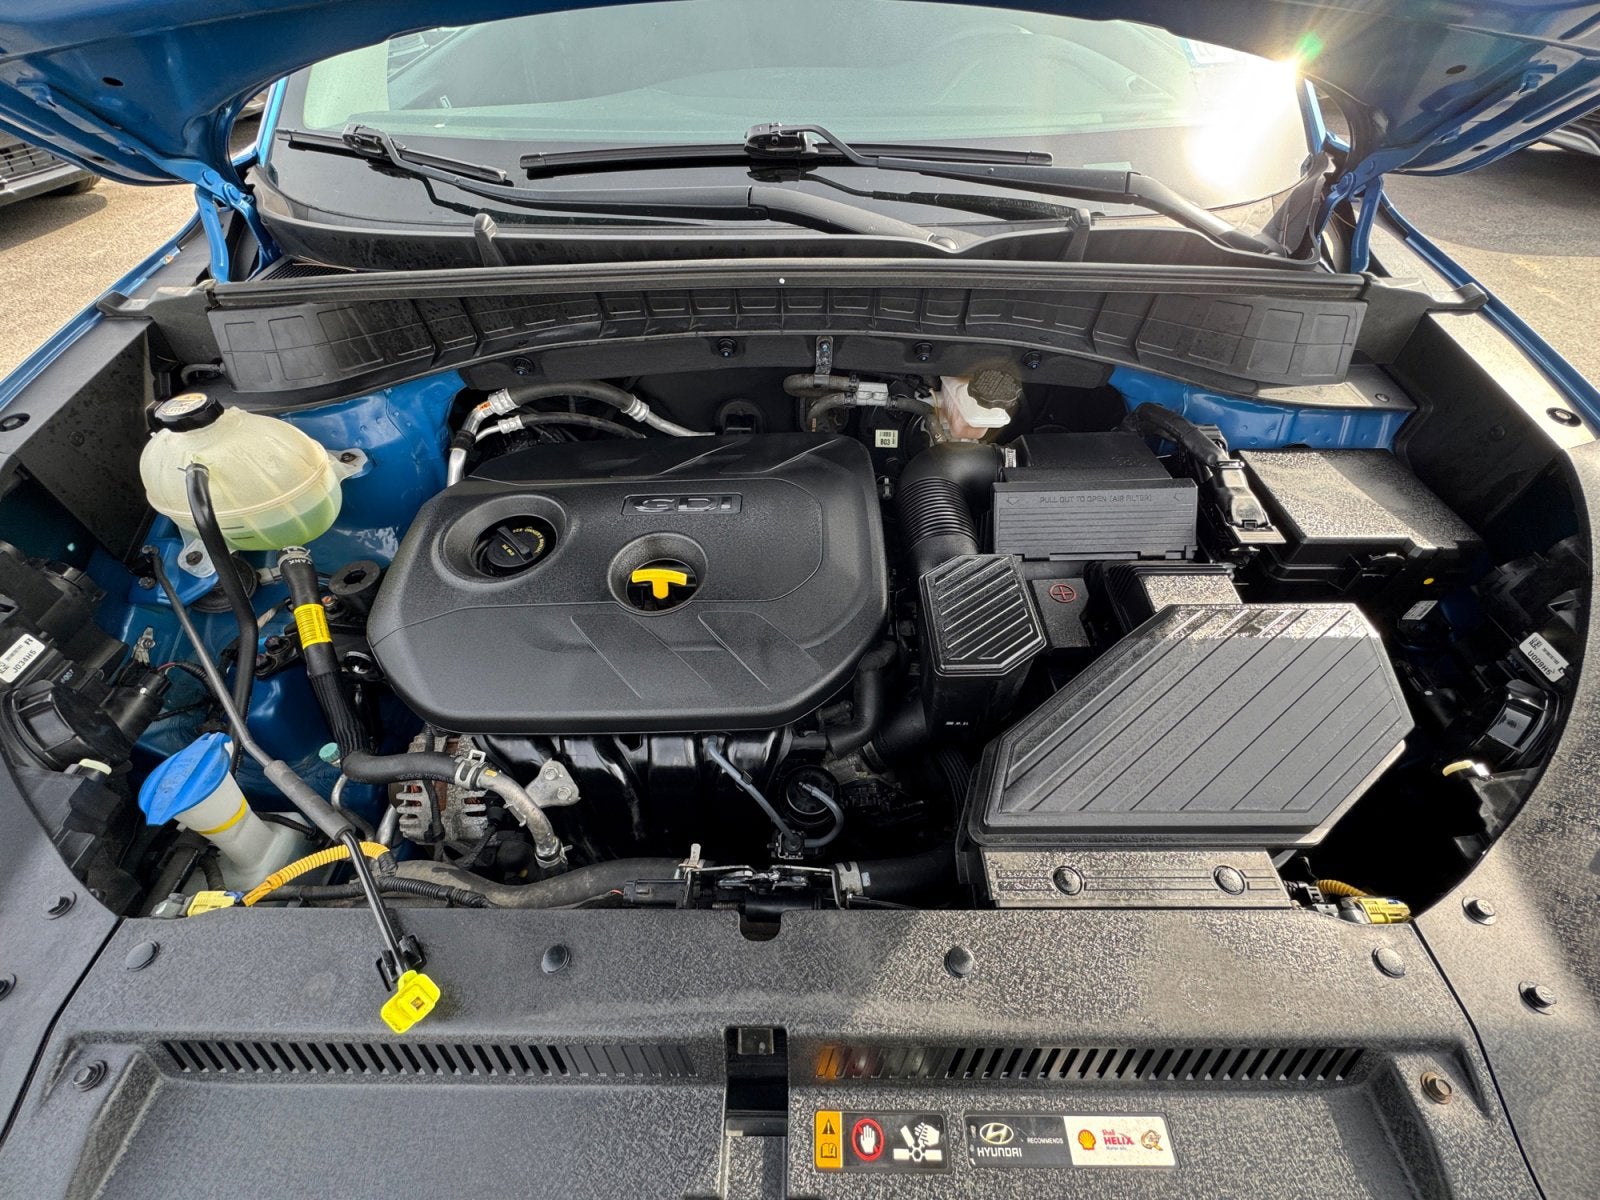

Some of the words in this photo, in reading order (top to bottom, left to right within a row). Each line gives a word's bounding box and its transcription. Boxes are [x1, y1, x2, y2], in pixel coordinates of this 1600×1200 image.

[1039, 495, 1058, 504] PULL
[1059, 495, 1074, 503] OUT
[1076, 495, 1086, 503] TO
[1087, 495, 1106, 503] OPEN
[634, 497, 732, 512] GDI
[1103, 1136, 1135, 1145] HELIX
[977, 1147, 1022, 1157] HYUNDAI
